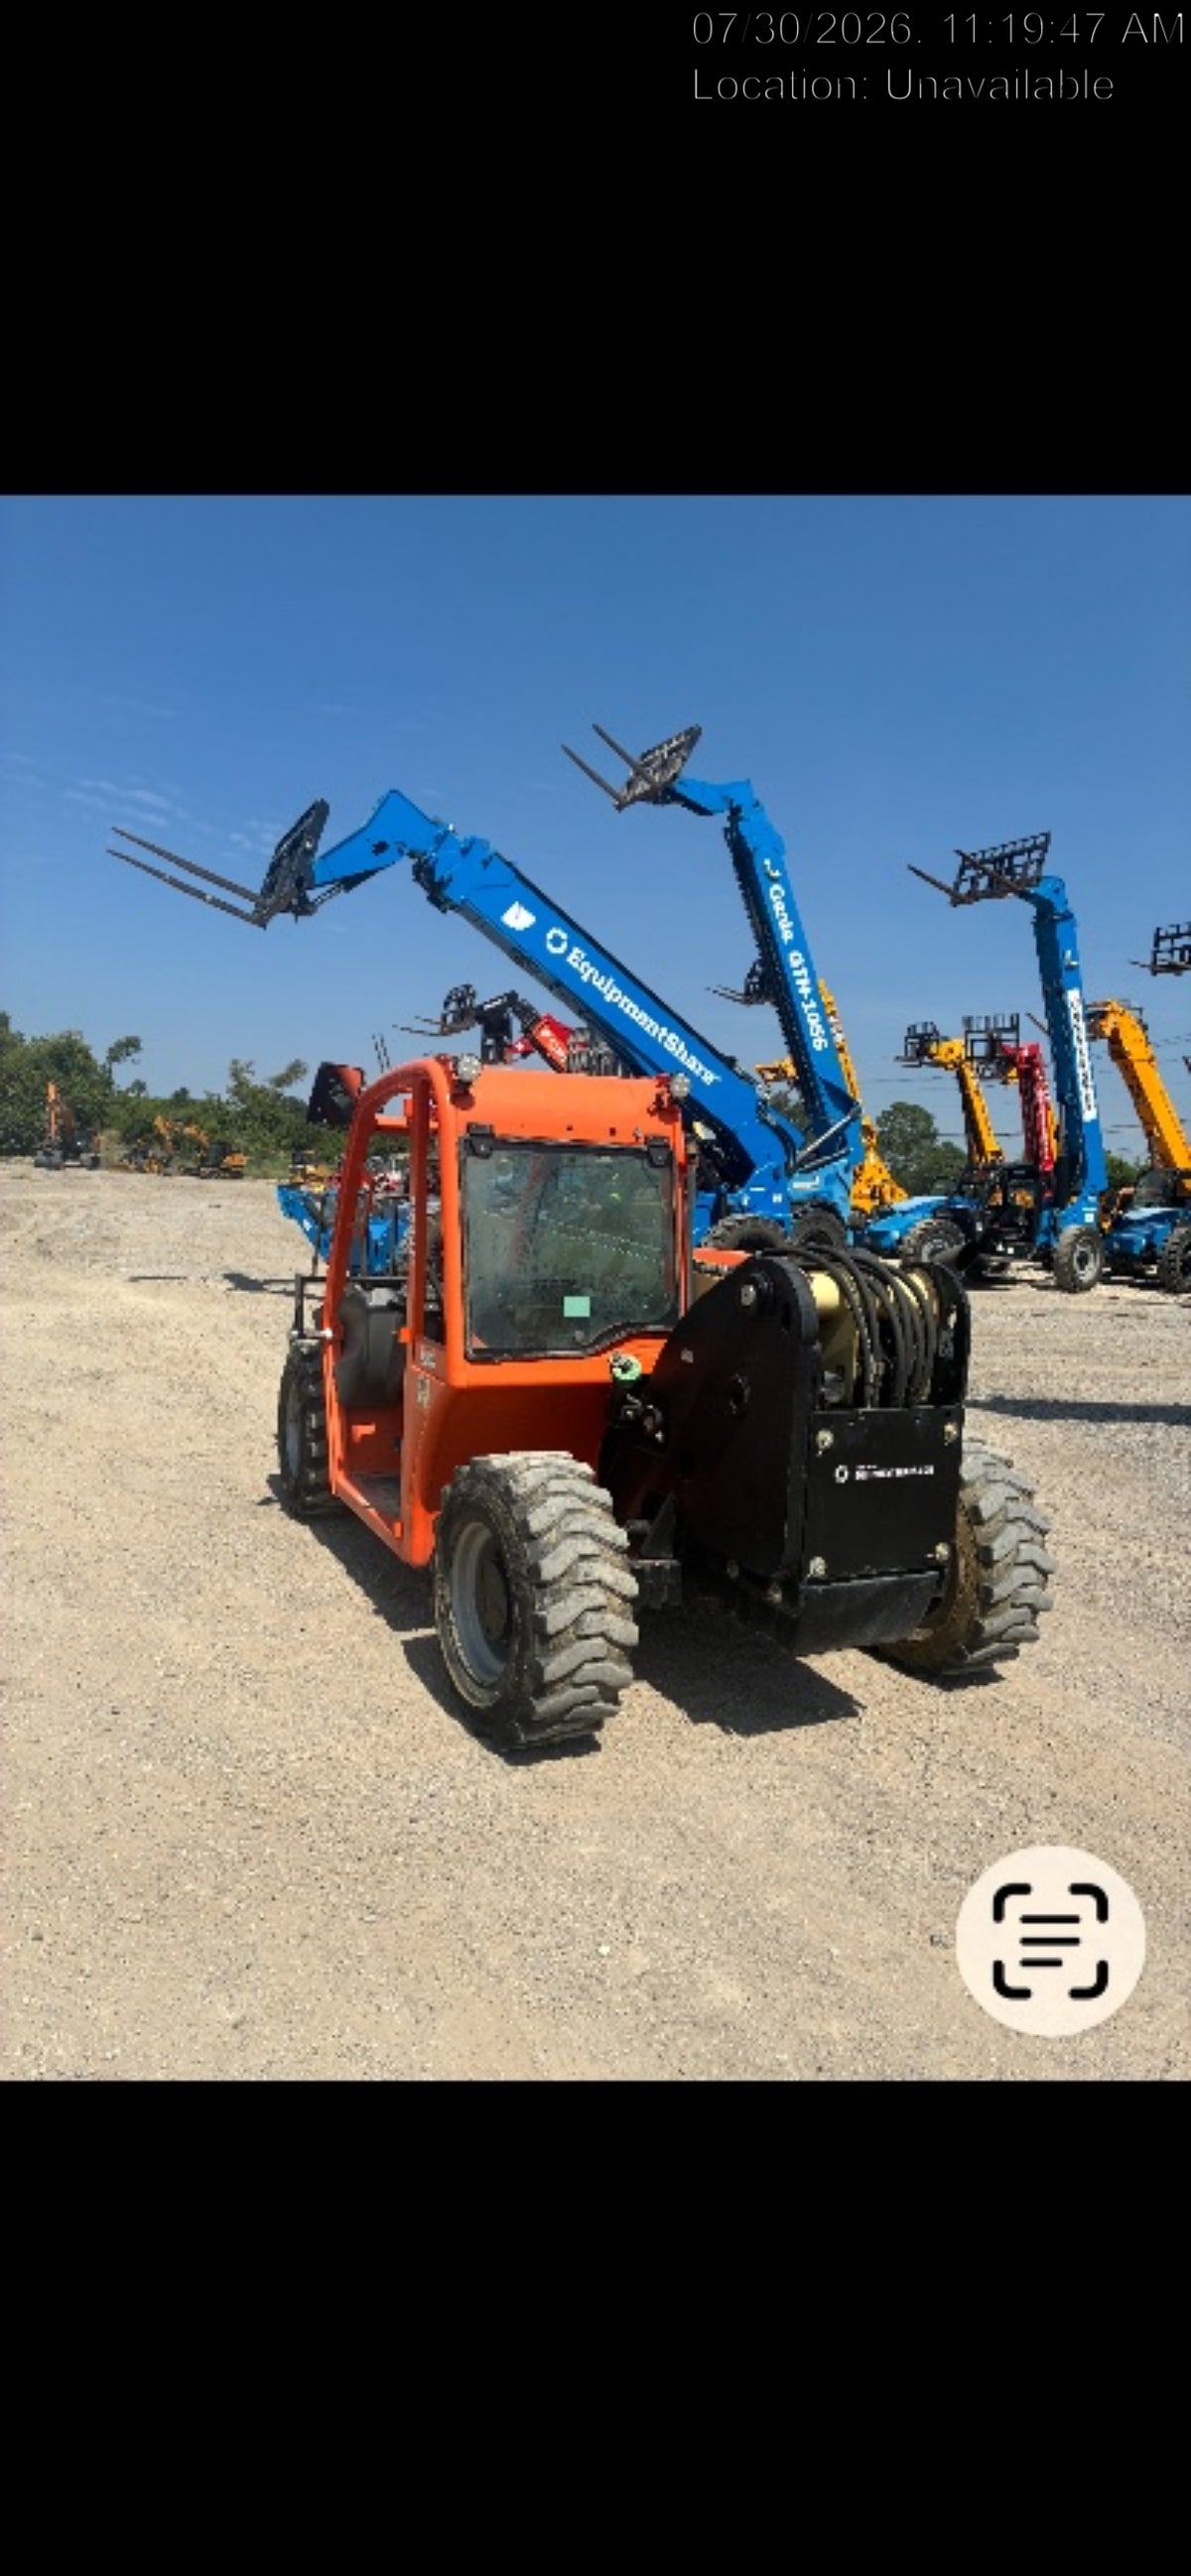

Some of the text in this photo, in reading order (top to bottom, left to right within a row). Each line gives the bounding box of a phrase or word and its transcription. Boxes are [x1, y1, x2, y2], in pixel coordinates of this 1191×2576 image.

[566, 946, 717, 1087] EquipmentShare
[769, 883, 828, 1052] Genie GTH-1056
